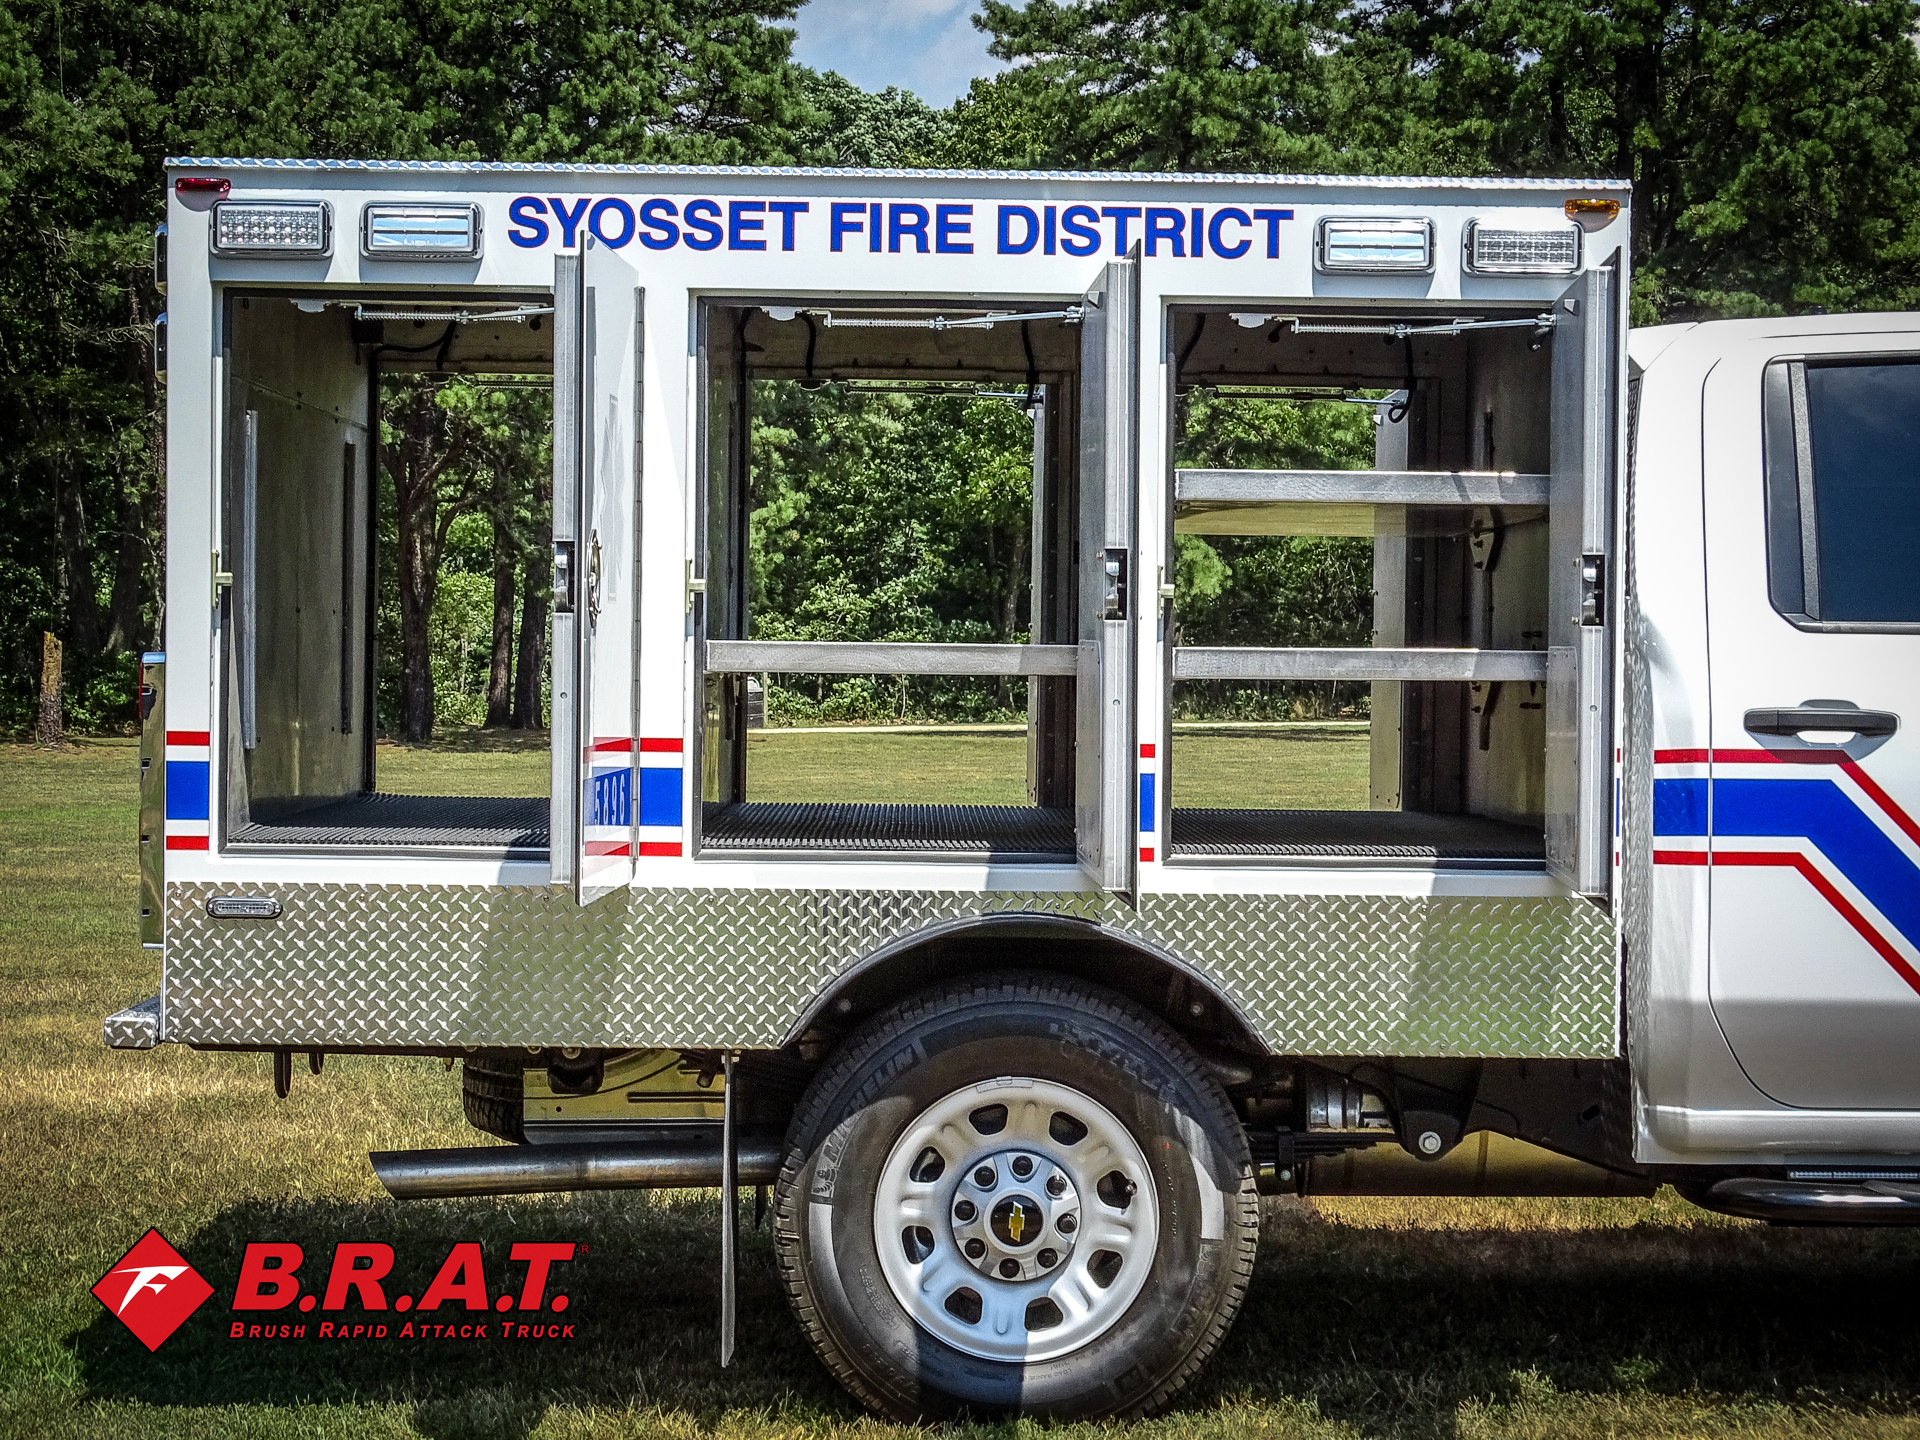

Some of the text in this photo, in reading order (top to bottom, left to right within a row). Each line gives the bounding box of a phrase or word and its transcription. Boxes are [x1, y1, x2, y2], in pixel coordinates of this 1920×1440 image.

[507, 196, 1294, 259] SYOSSET FIRE DISTRICT
[594, 773, 626, 828] 5896
